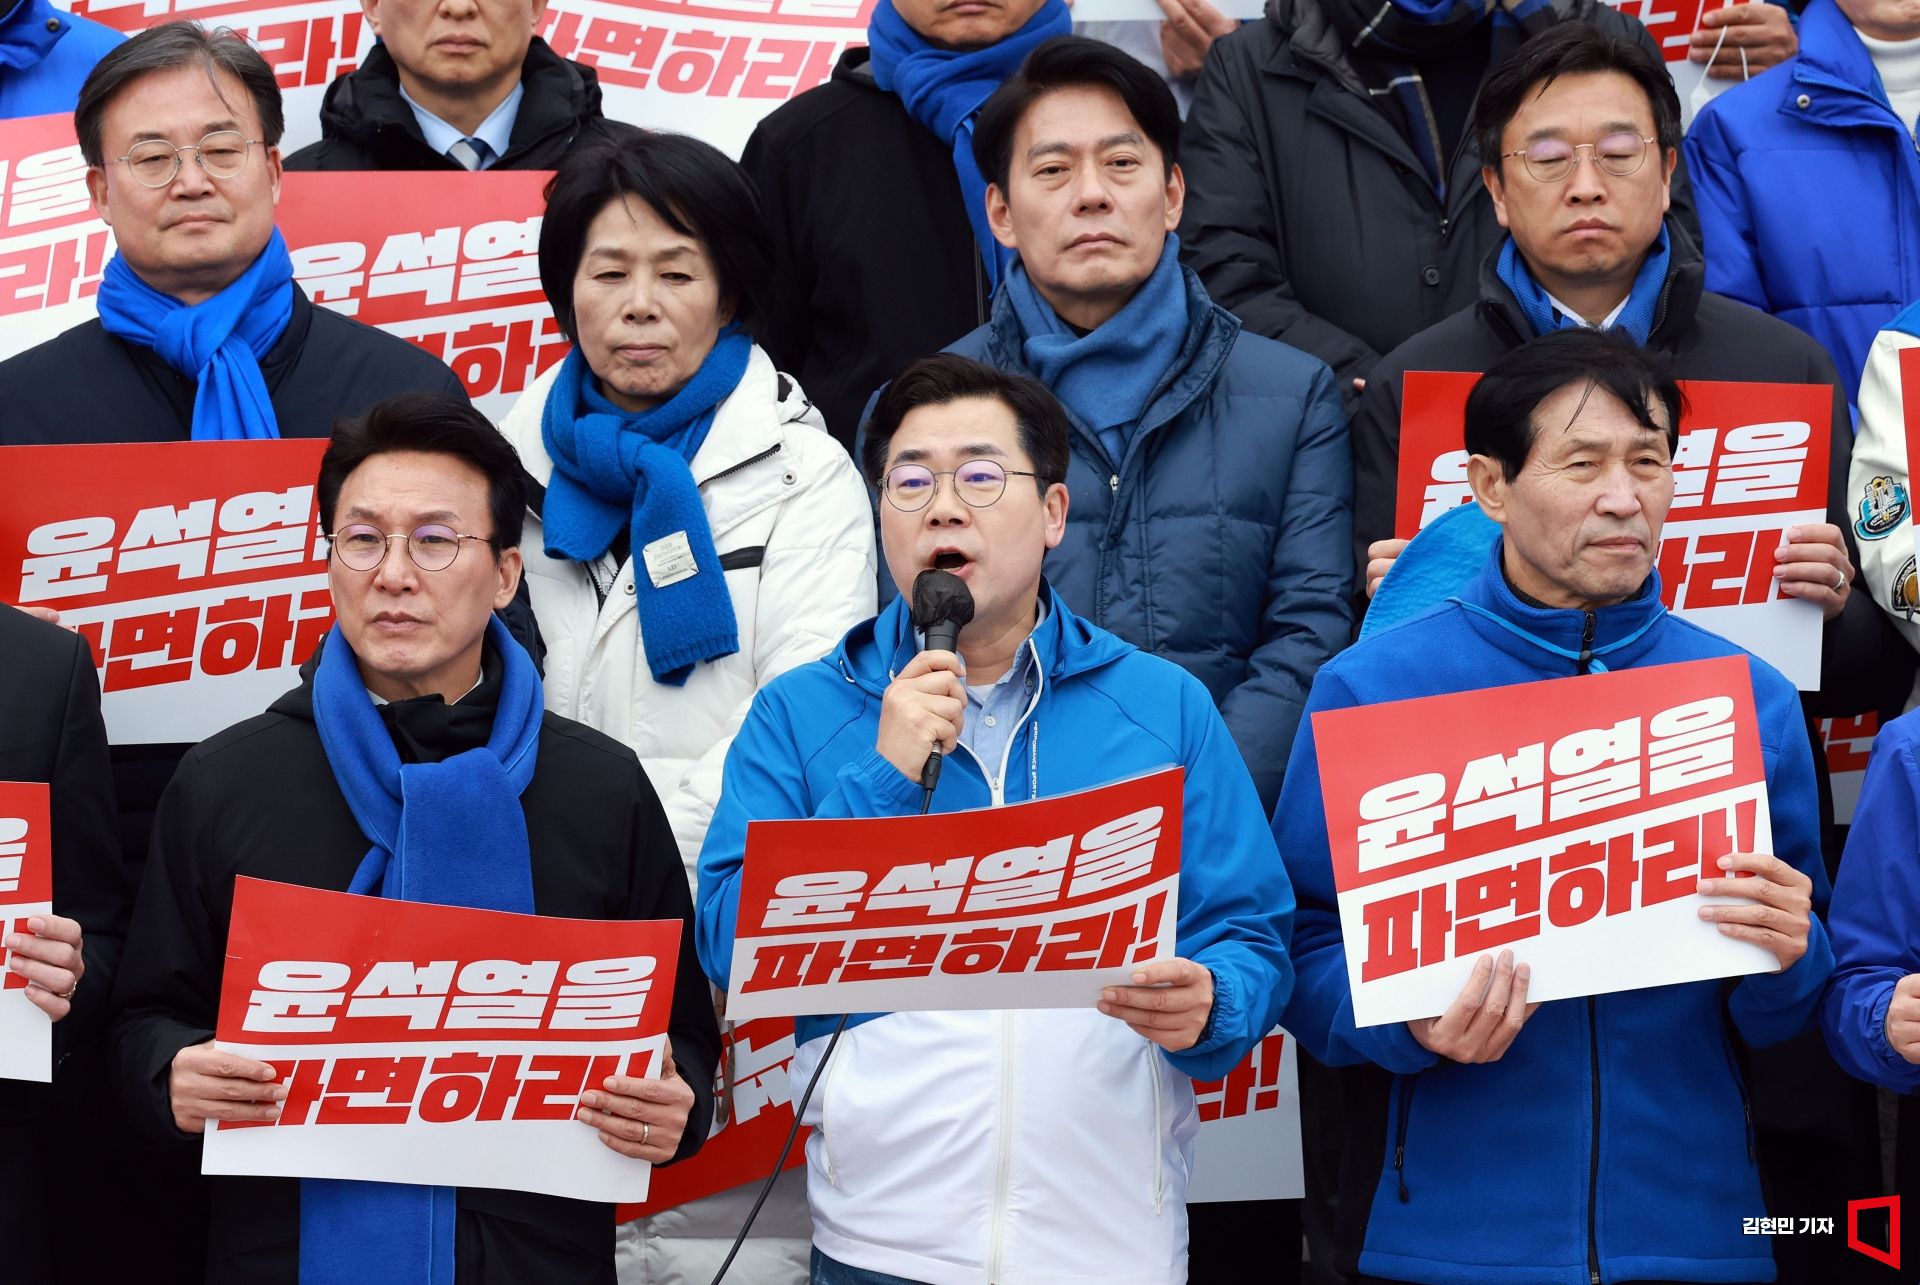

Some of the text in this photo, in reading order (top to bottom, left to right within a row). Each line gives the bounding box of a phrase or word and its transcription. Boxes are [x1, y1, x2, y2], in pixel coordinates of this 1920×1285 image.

[18, 485, 329, 603] 윤석열
[1357, 696, 1736, 874] 윤석열을
[760, 806, 1164, 929] 윤석열을
[1362, 798, 1757, 984] 파면하라!
[241, 956, 657, 1032] 윤석열을
[740, 889, 1169, 994] 파면하라!
